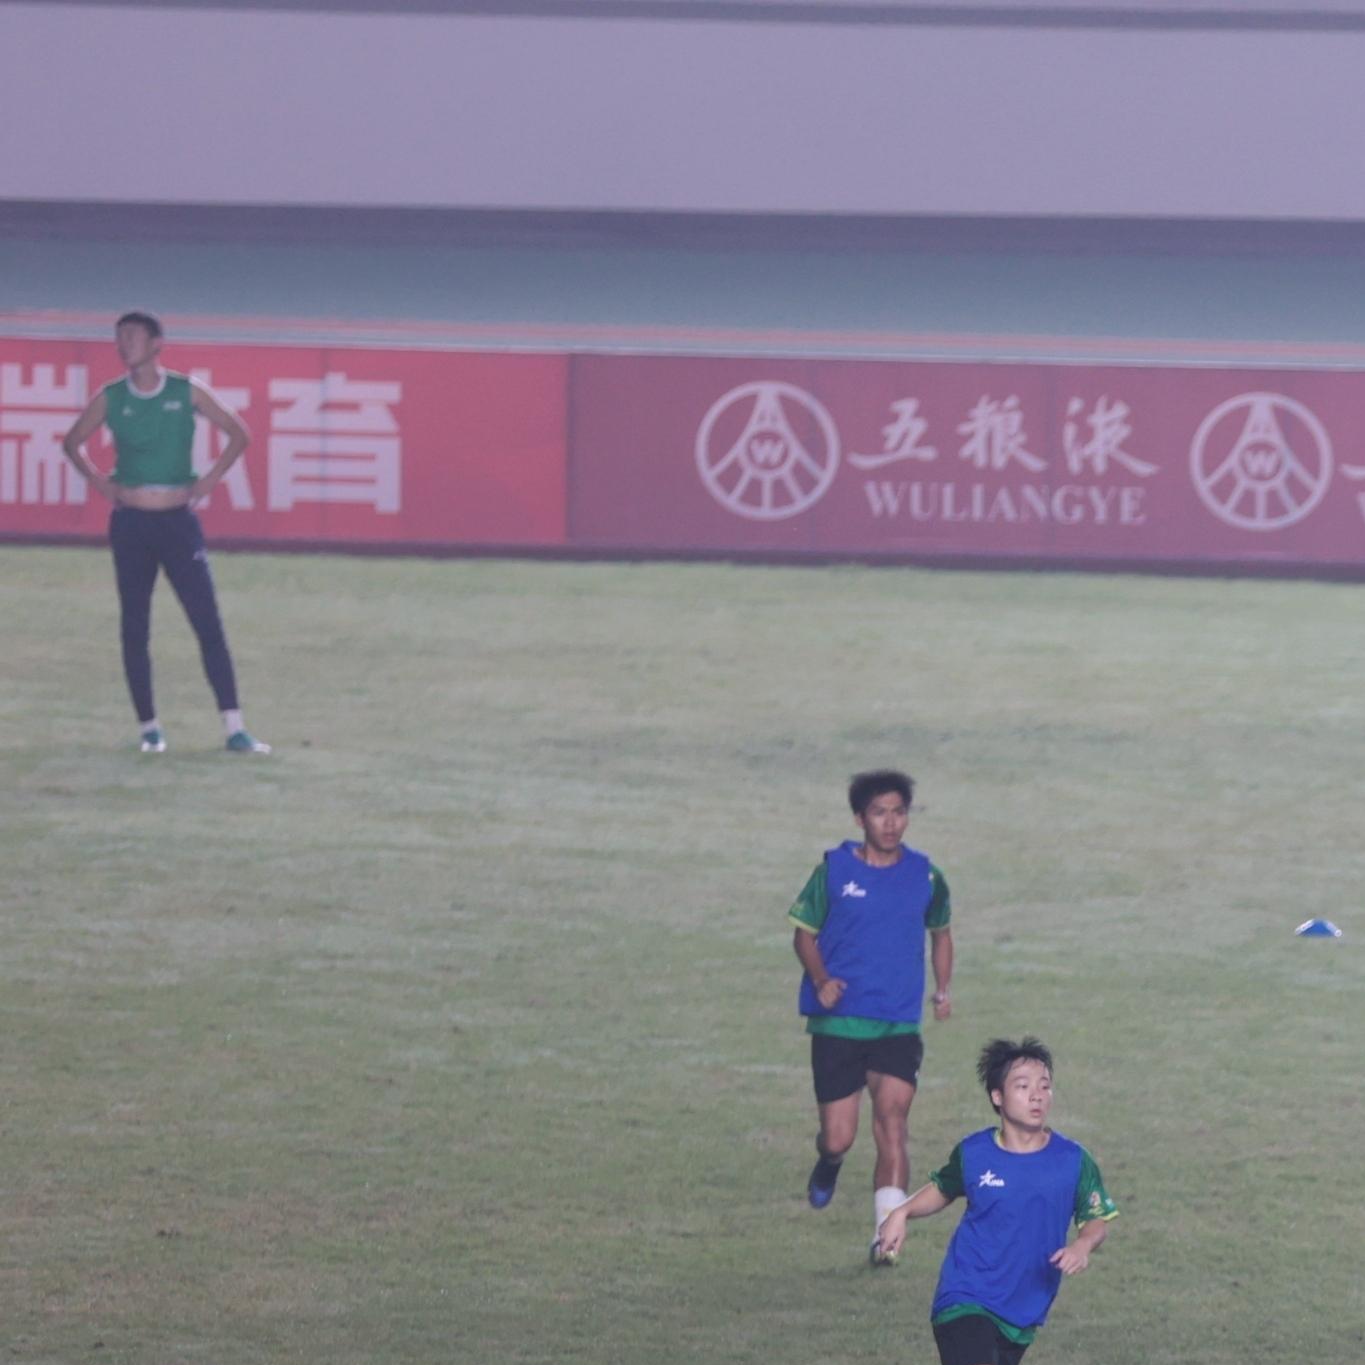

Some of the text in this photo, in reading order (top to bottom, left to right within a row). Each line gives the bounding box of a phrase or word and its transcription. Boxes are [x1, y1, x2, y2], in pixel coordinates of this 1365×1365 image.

[847, 394, 1160, 476] 五粮液
[862, 480, 1148, 525] WULIANGYE
